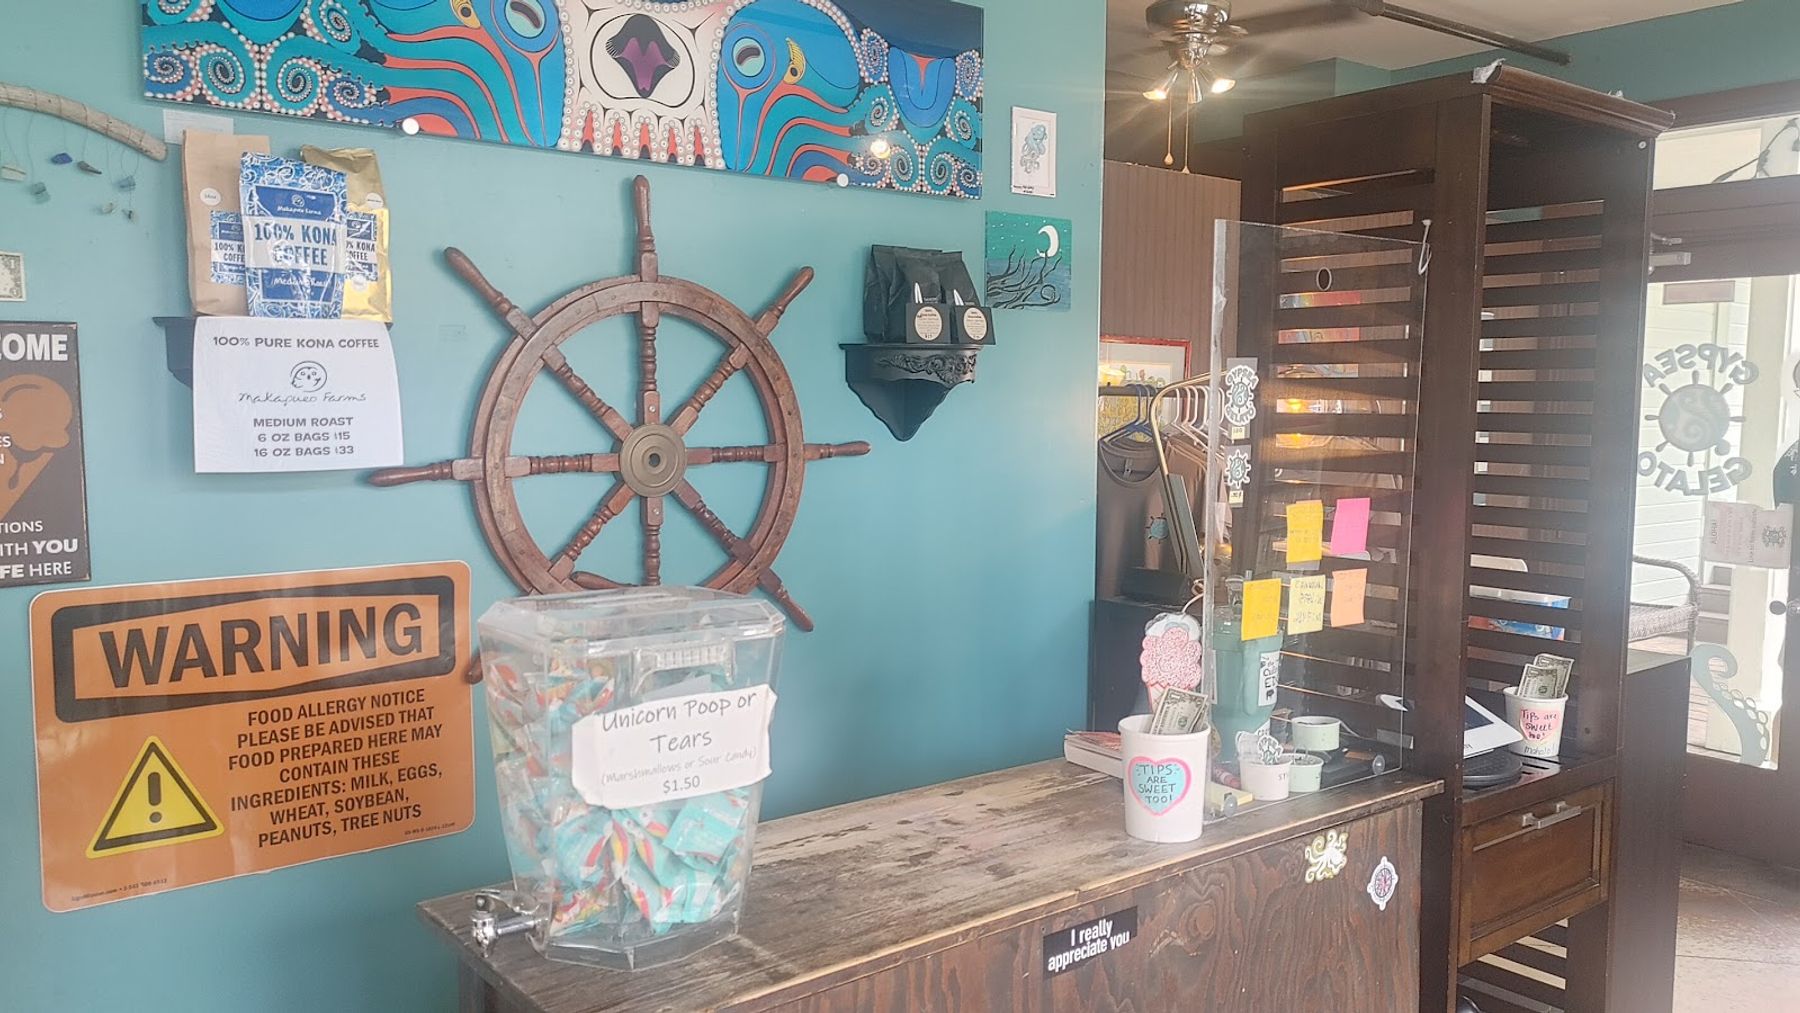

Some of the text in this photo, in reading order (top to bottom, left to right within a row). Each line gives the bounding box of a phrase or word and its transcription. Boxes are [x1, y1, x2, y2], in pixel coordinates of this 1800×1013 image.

[0, 332, 68, 361] OME
[213, 336, 380, 349] 100% PURE KONA COFFEE
[253, 416, 354, 428] MEDIUM ROAST
[257, 433, 267, 442] 6
[271, 433, 290, 442] OZ
[294, 432, 330, 442] BAGS
[254, 448, 268, 457] 16
[272, 448, 291, 457] OZ
[295, 446, 331, 456] BAGS
[31, 538, 78, 554] YOU
[29, 561, 72, 577] HERE
[99, 602, 424, 689] WARNING
[248, 689, 425, 726] FOOD ALLERGY NOTICE
[601, 691, 757, 732] Unicorn Poop or
[237, 706, 435, 748] PLEASE BE ADVISED THAT
[228, 724, 443, 770] FOOD PREPARED HERE MAY
[649, 730, 713, 754] Tears
[279, 750, 400, 783] CONTAIN THESE
[684, 760, 694, 769] or
[698, 755, 721, 767] Sour
[1138, 764, 1173, 775] TIPS
[231, 763, 443, 811] INGREDIENTS: MILK, EGGS,
[663, 775, 701, 793] $1.50
[1138, 783, 1176, 794] SWEET
[1146, 776, 1168, 784] ARE
[270, 788, 410, 825] WHEAT, SOYBEAN,
[258, 821, 337, 848] PEANUTS,
[340, 812, 380, 833] TREE
[383, 805, 422, 824] NUTS
[1071, 919, 1113, 946] I really
[1048, 931, 1131, 972] appreciate you
